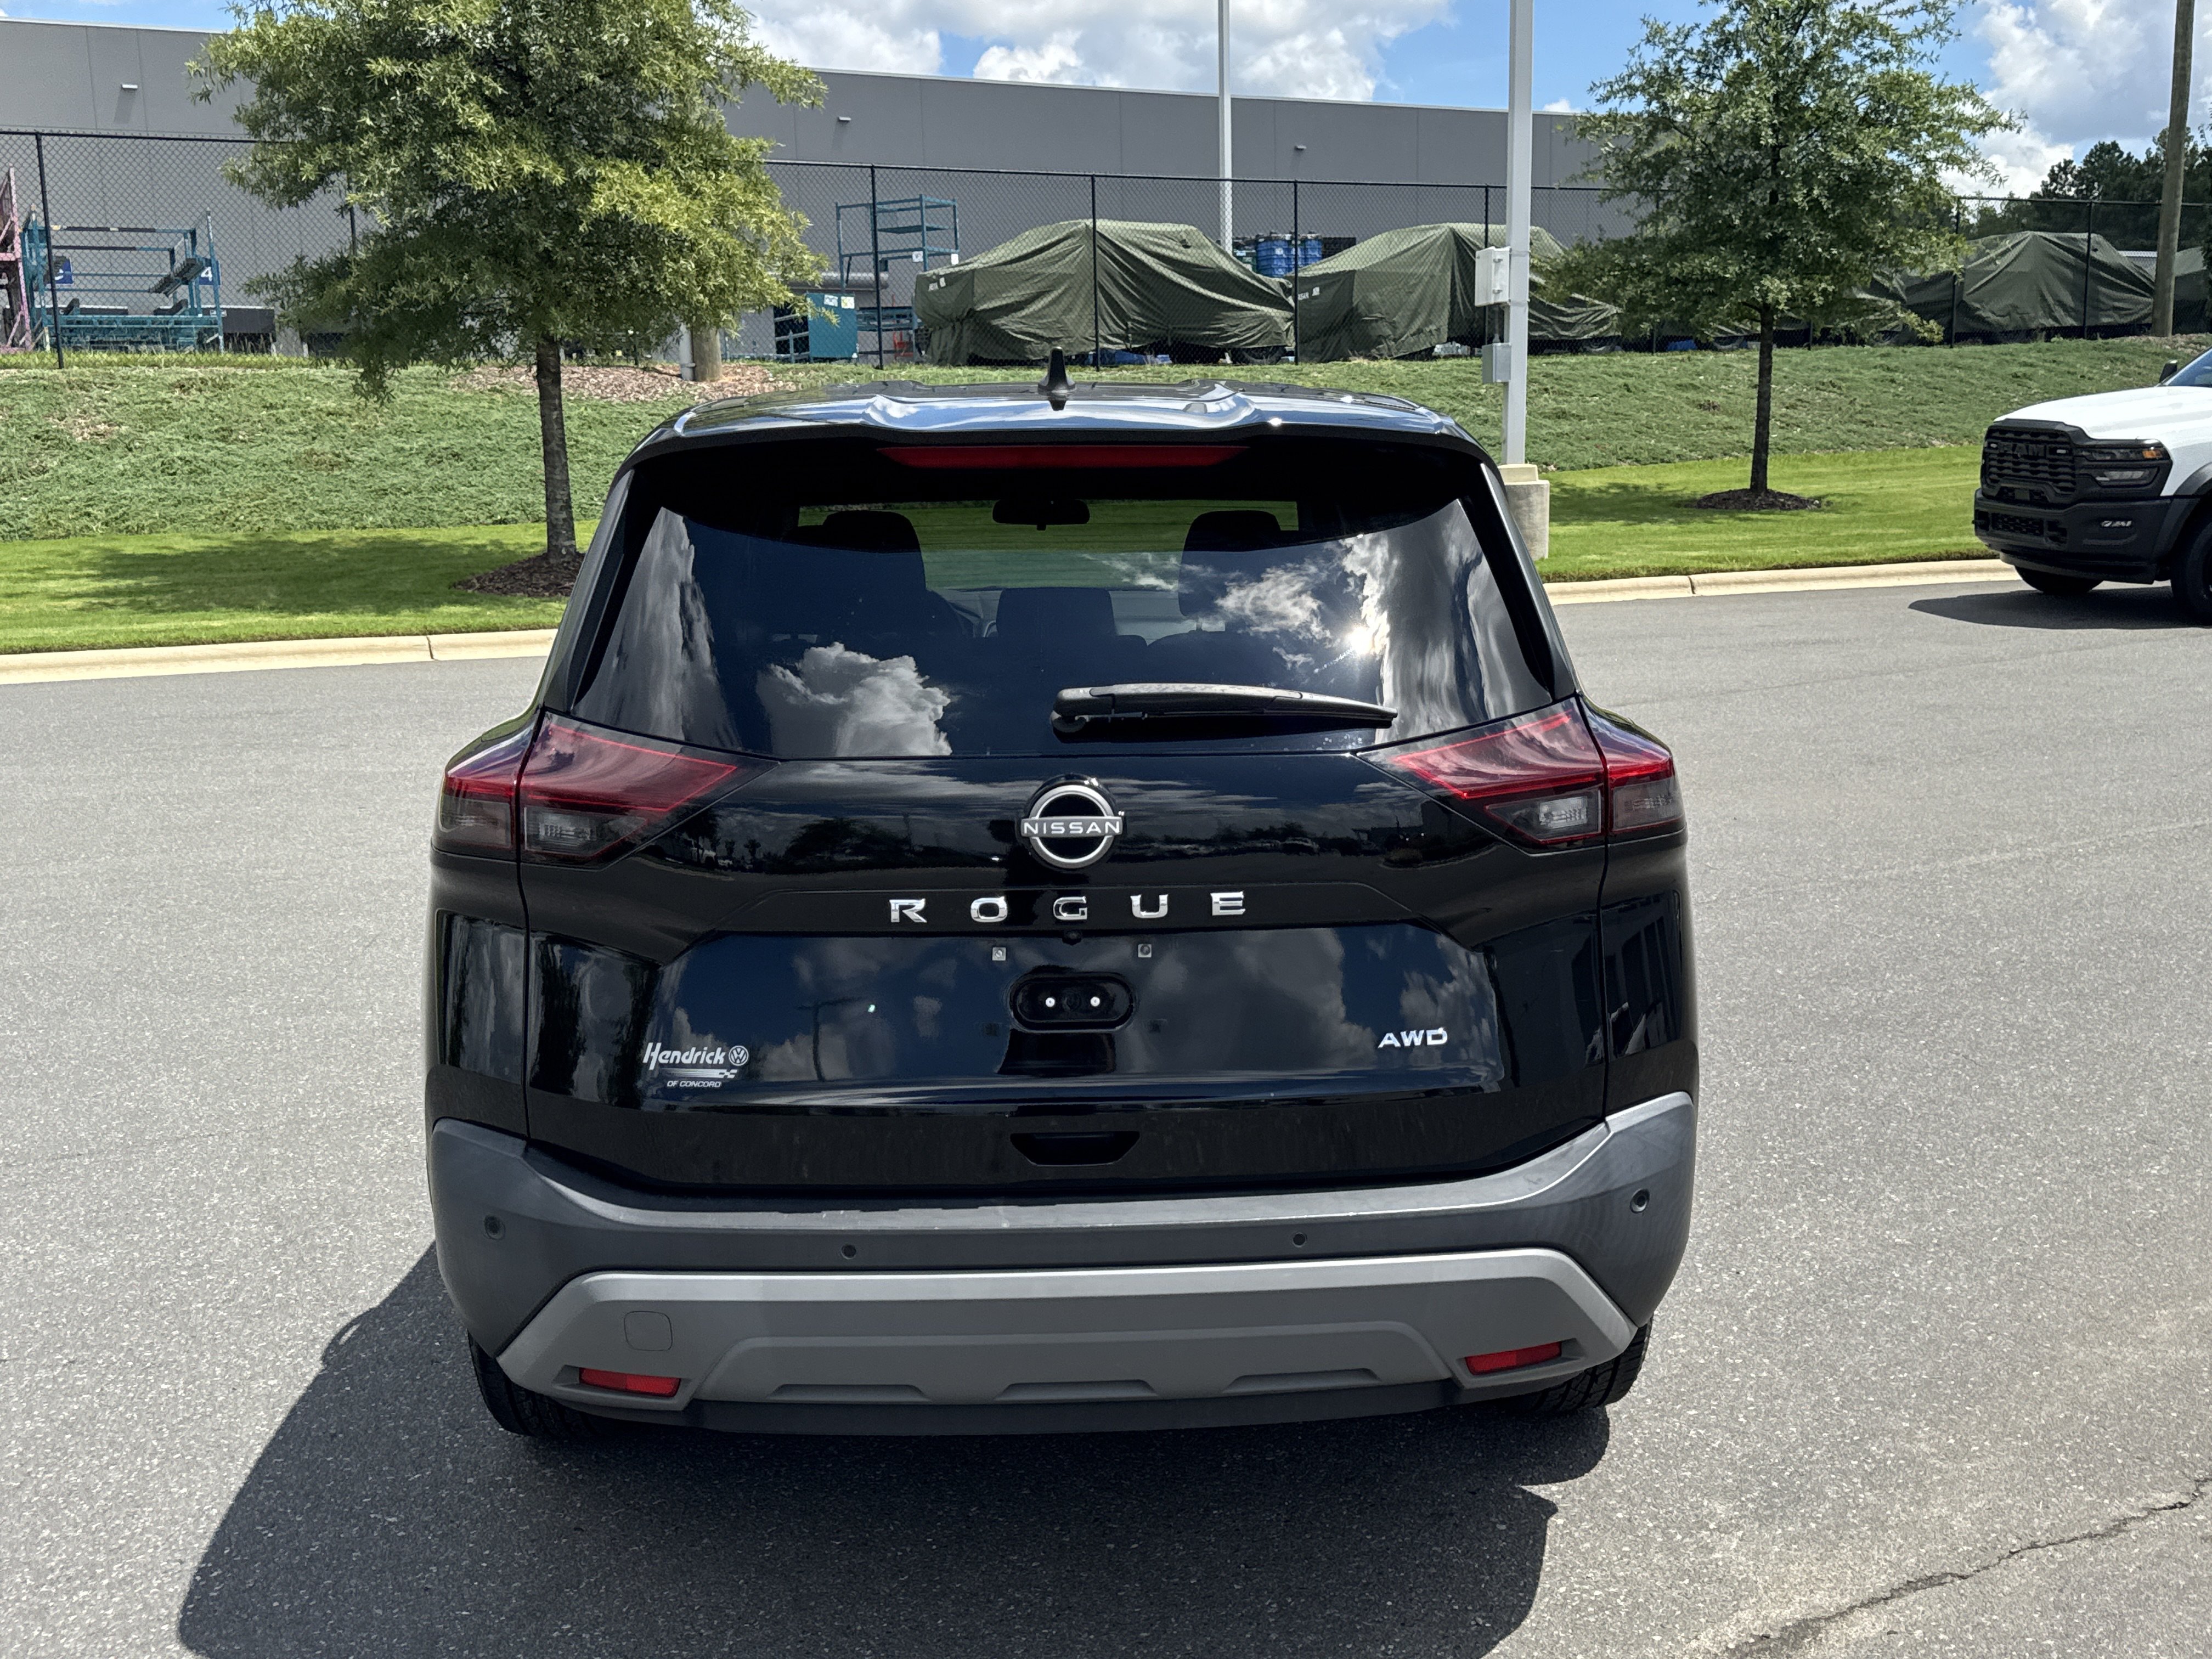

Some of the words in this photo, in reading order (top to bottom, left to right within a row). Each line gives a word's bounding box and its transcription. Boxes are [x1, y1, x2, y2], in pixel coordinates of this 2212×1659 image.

[1024, 821, 1120, 834] NISSAN
[889, 890, 1246, 923] ROGUE
[1378, 1027, 1448, 1048] AWD
[642, 1042, 726, 1070] Hendrick
